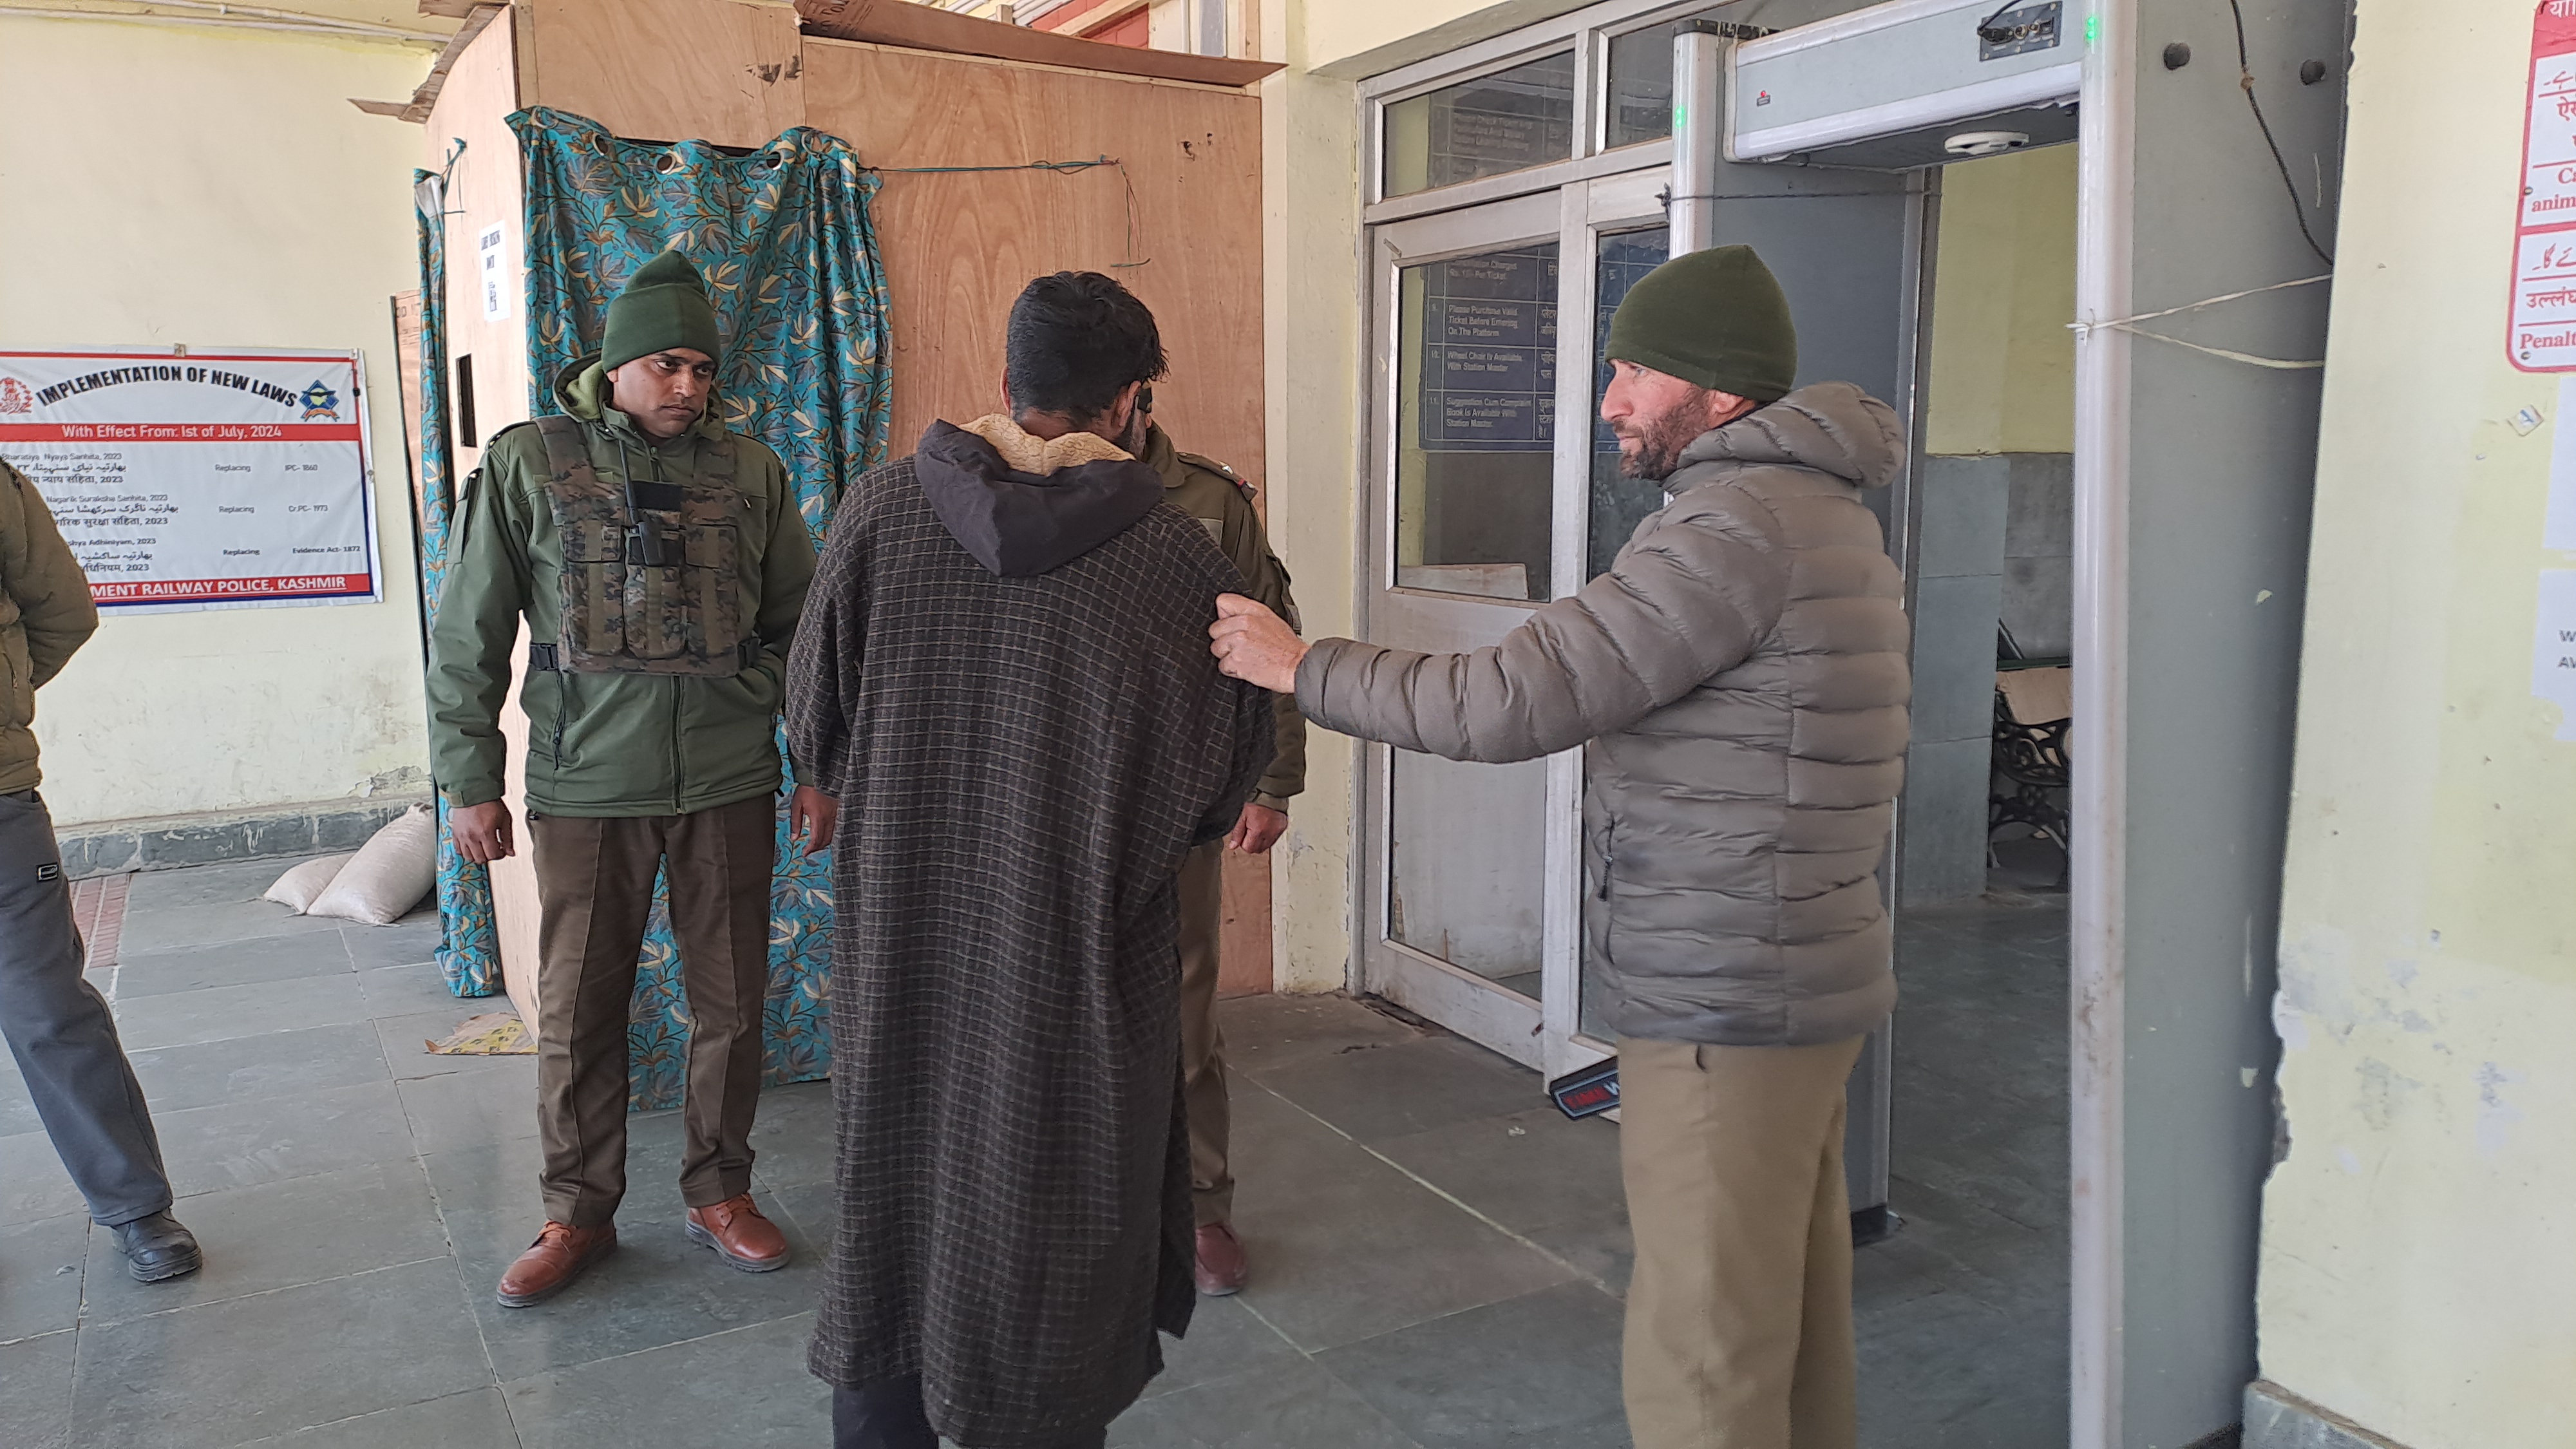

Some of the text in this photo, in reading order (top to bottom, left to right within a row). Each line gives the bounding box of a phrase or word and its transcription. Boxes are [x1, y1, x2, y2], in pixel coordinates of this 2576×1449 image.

[35, 365, 298, 407] IMPLEMENTATION OF NEW LAWS
[61, 424, 94, 438] With
[97, 424, 137, 438] Effect
[139, 425, 178, 439] From:
[201, 425, 215, 438] of
[217, 425, 249, 440] July,
[250, 425, 282, 438] 2024
[214, 464, 252, 473] Replacing
[100, 475, 124, 484] 2023
[218, 506, 255, 514] Replacing
[144, 517, 168, 526] 2023
[223, 548, 260, 556] Replacing
[126, 564, 150, 572] 2023
[90, 576, 346, 597] MENT RAILWAY POLICE, KASHMIR
